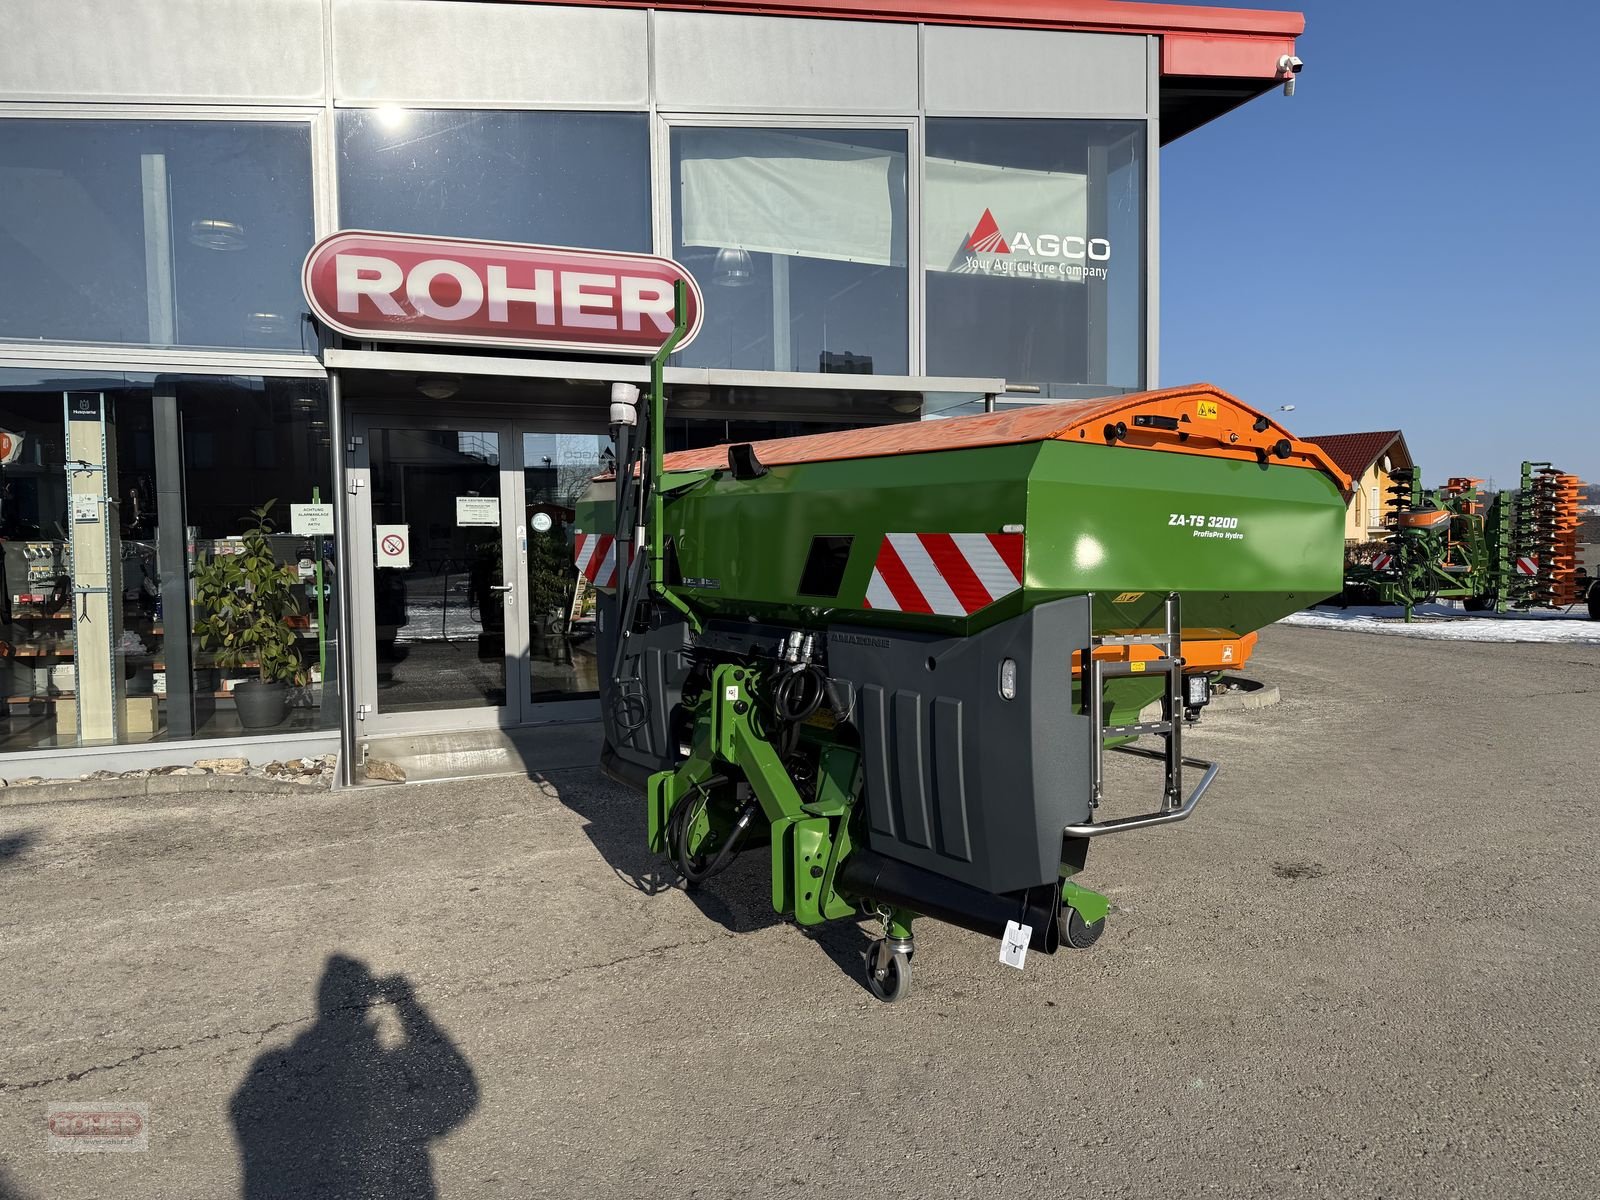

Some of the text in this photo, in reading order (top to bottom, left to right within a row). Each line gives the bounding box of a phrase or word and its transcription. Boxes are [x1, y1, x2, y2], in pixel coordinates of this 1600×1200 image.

[1010, 231, 1111, 261] AGCO
[966, 256, 1108, 281] Your Agriculture Company
[335, 253, 676, 334] ROHER
[1168, 513, 1239, 529] ZA-TS 3200
[1193, 530, 1244, 541] ProfisPro Hydro
[831, 632, 891, 649] AMAZONE
